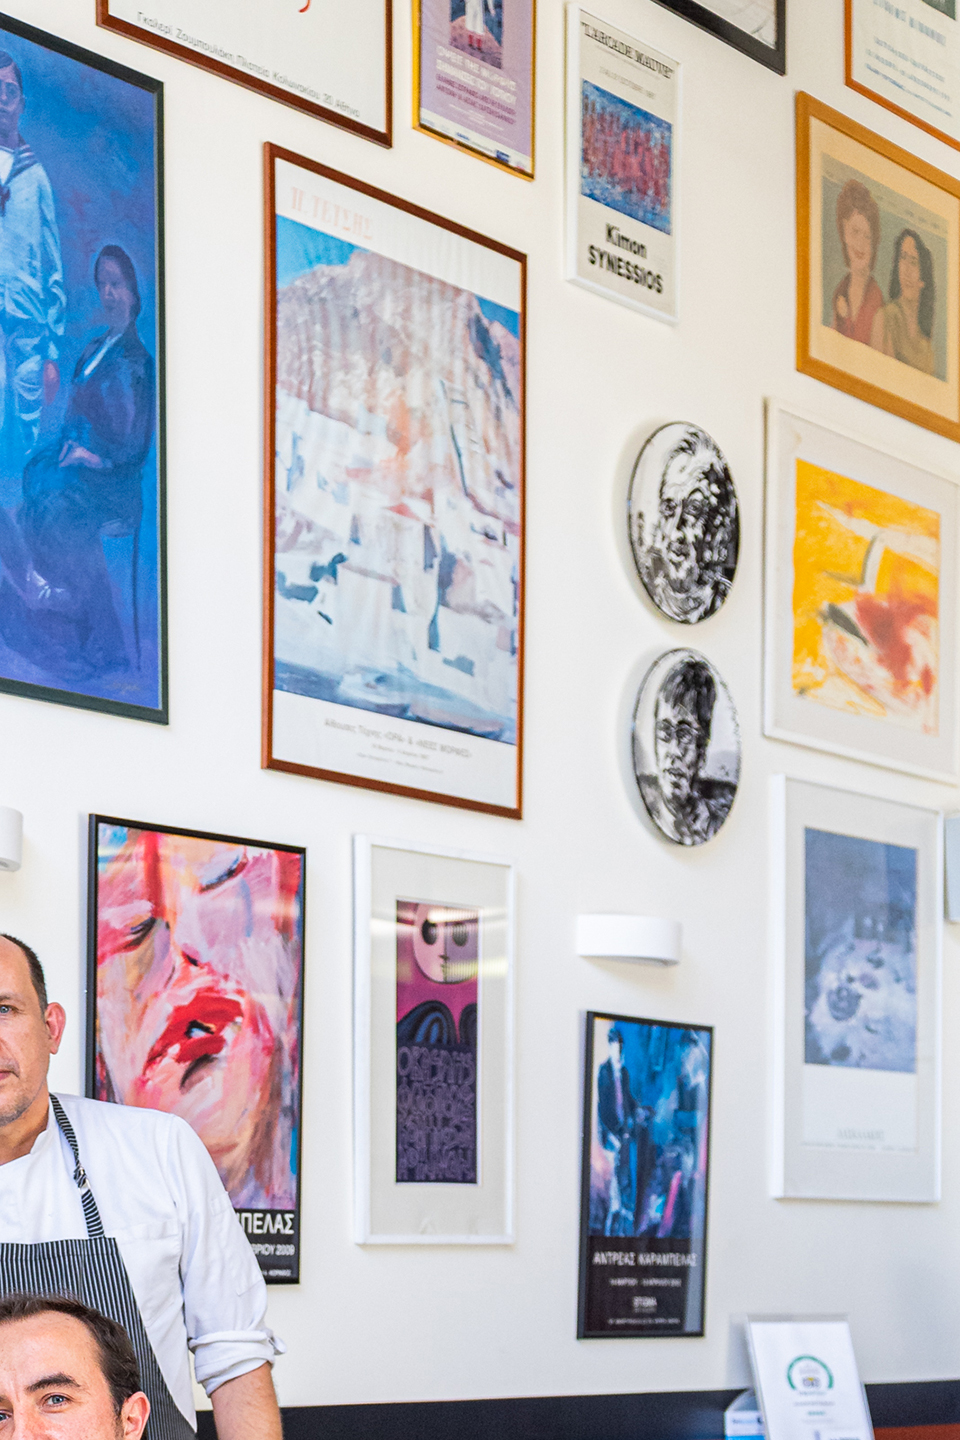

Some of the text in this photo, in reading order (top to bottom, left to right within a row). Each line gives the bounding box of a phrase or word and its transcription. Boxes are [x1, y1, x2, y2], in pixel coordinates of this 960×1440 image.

[606, 223, 647, 259] Kimon
[588, 244, 663, 294] SYNESSIOS
[236, 1212, 295, 1234] ΠΕΛΑΣ
